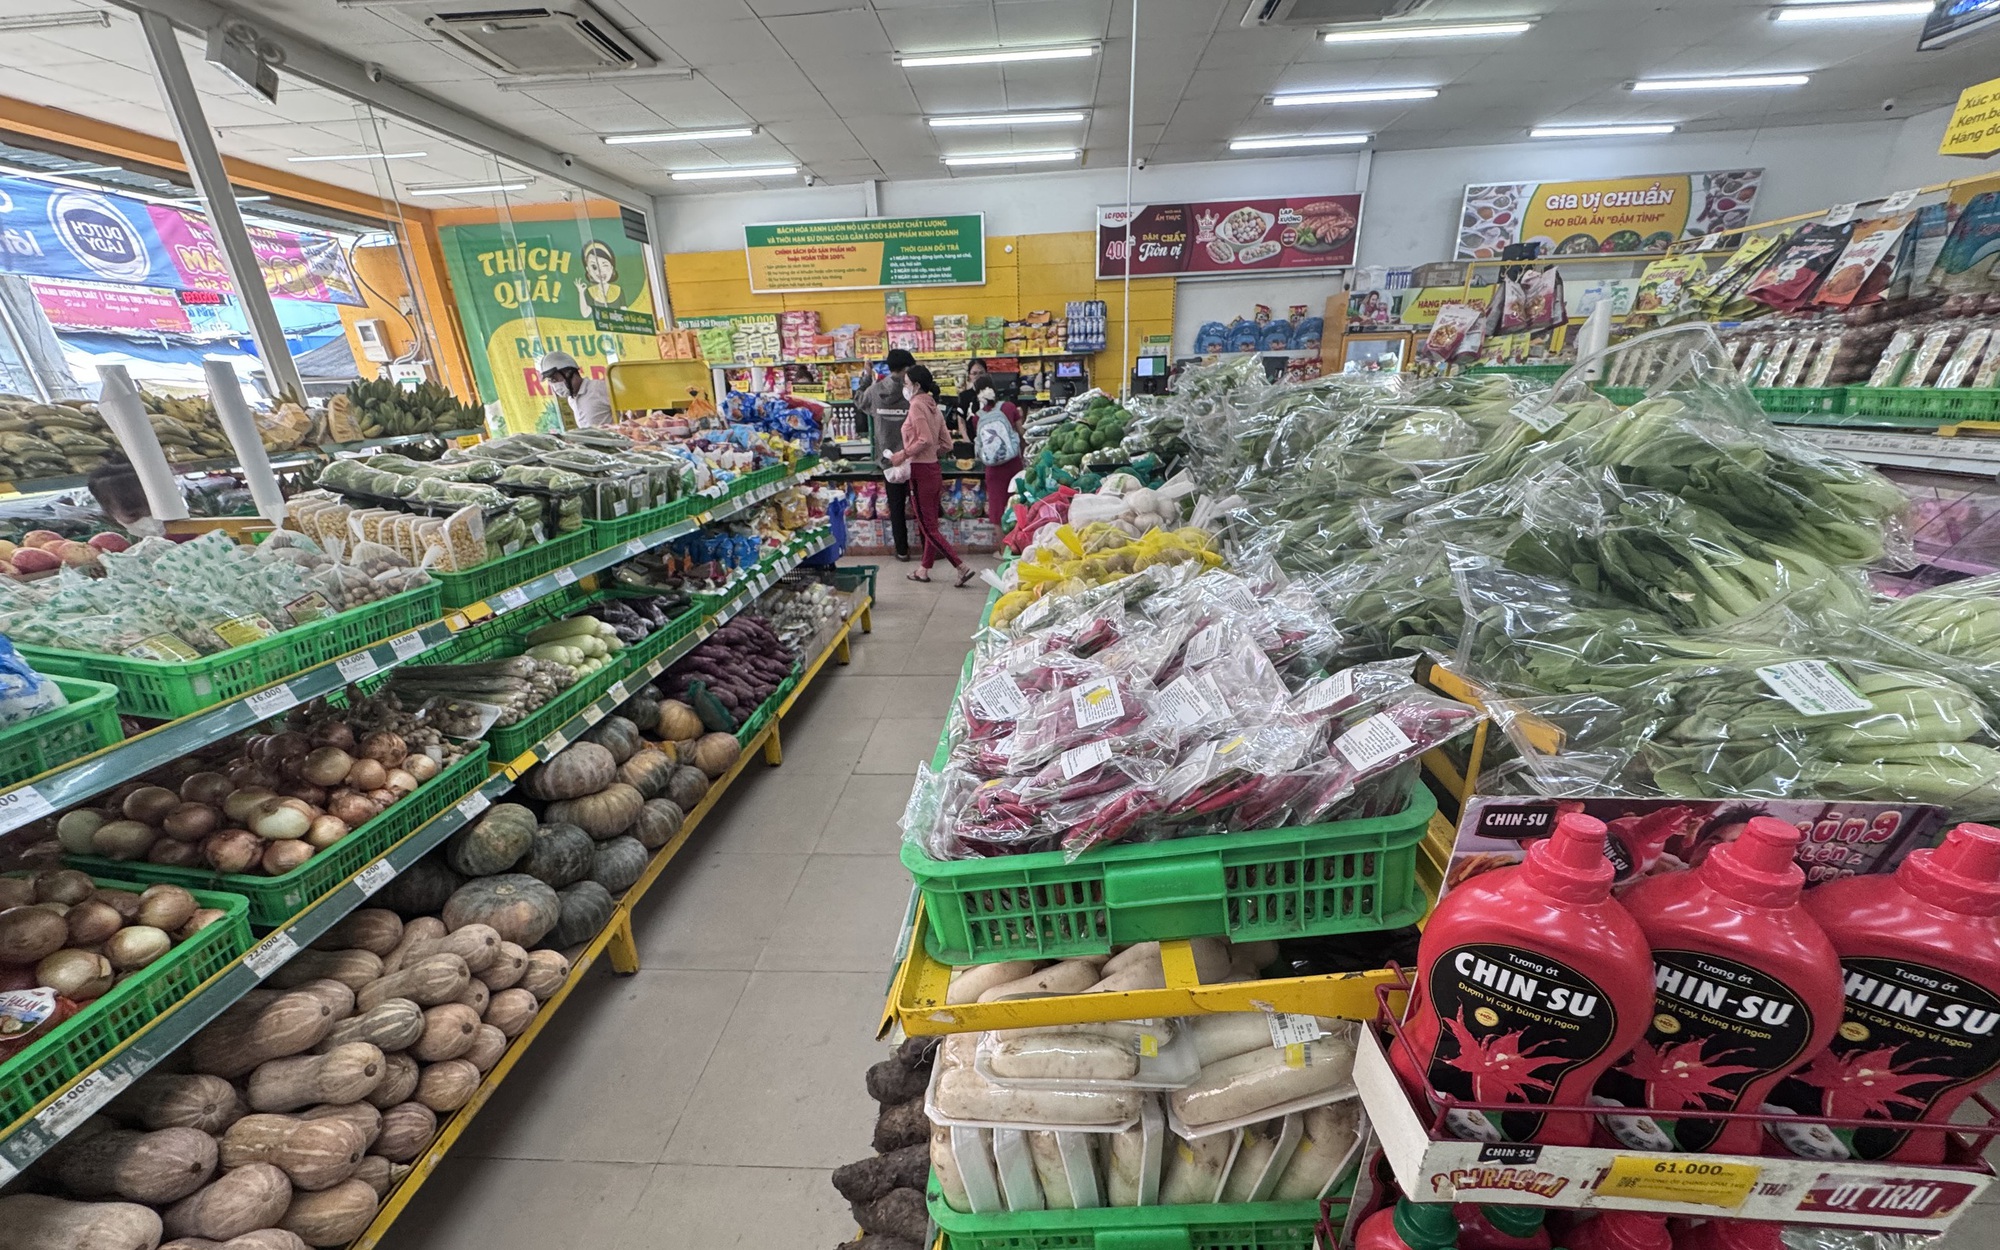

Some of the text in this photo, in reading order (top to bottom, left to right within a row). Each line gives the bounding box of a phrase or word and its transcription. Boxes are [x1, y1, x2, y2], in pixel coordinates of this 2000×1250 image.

[777, 226, 794, 235] BÁCH
[828, 224, 846, 232] LUÔN
[857, 223, 870, 232] LỰC
[888, 220, 904, 229] SOÁT
[905, 220, 923, 228] CHẤT
[924, 219, 947, 228] LƯỢNG
[1544, 217, 1566, 228] CHO
[1567, 213, 1588, 227] BỮA
[1590, 213, 1605, 226] ĂN
[767, 236, 776, 244] VÀ
[816, 234, 835, 243] DỤNG
[836, 232, 849, 241] CỦA
[918, 229, 935, 237] KINH
[935, 228, 959, 237] DOANH
[1161, 230, 1186, 242] CHẤT
[478, 241, 572, 277] THÍCH
[494, 274, 562, 309] QUÁ!
[340, 653, 366, 667] 19.000
[251, 687, 282, 704] 16.000
[1485, 813, 1549, 827] CHIN-SU
[248, 936, 279, 962] 22.000
[1508, 952, 1559, 977] Tương ớt
[1697, 960, 1754, 985] Tương ớt
[1454, 951, 1598, 1018] CHIN-SU
[1895, 967, 1960, 993] Tương ớt
[1458, 981, 1580, 1032] Đượm vị cay, bùng vị ngon
[1652, 964, 1794, 1027] HIN-SU
[1843, 970, 2000, 1035] HIN-SU
[1667, 1001, 1772, 1040] vị cay, bùng vị ngon
[1856, 1010, 1973, 1048] vị cay, bùng vị ngon
[46, 1078, 95, 1116] 25.000
[1485, 1147, 1536, 1158] CHIN-SU
[1654, 1162, 1723, 1176] 61.000
[1868, 1181, 1943, 1212] TRÁI
